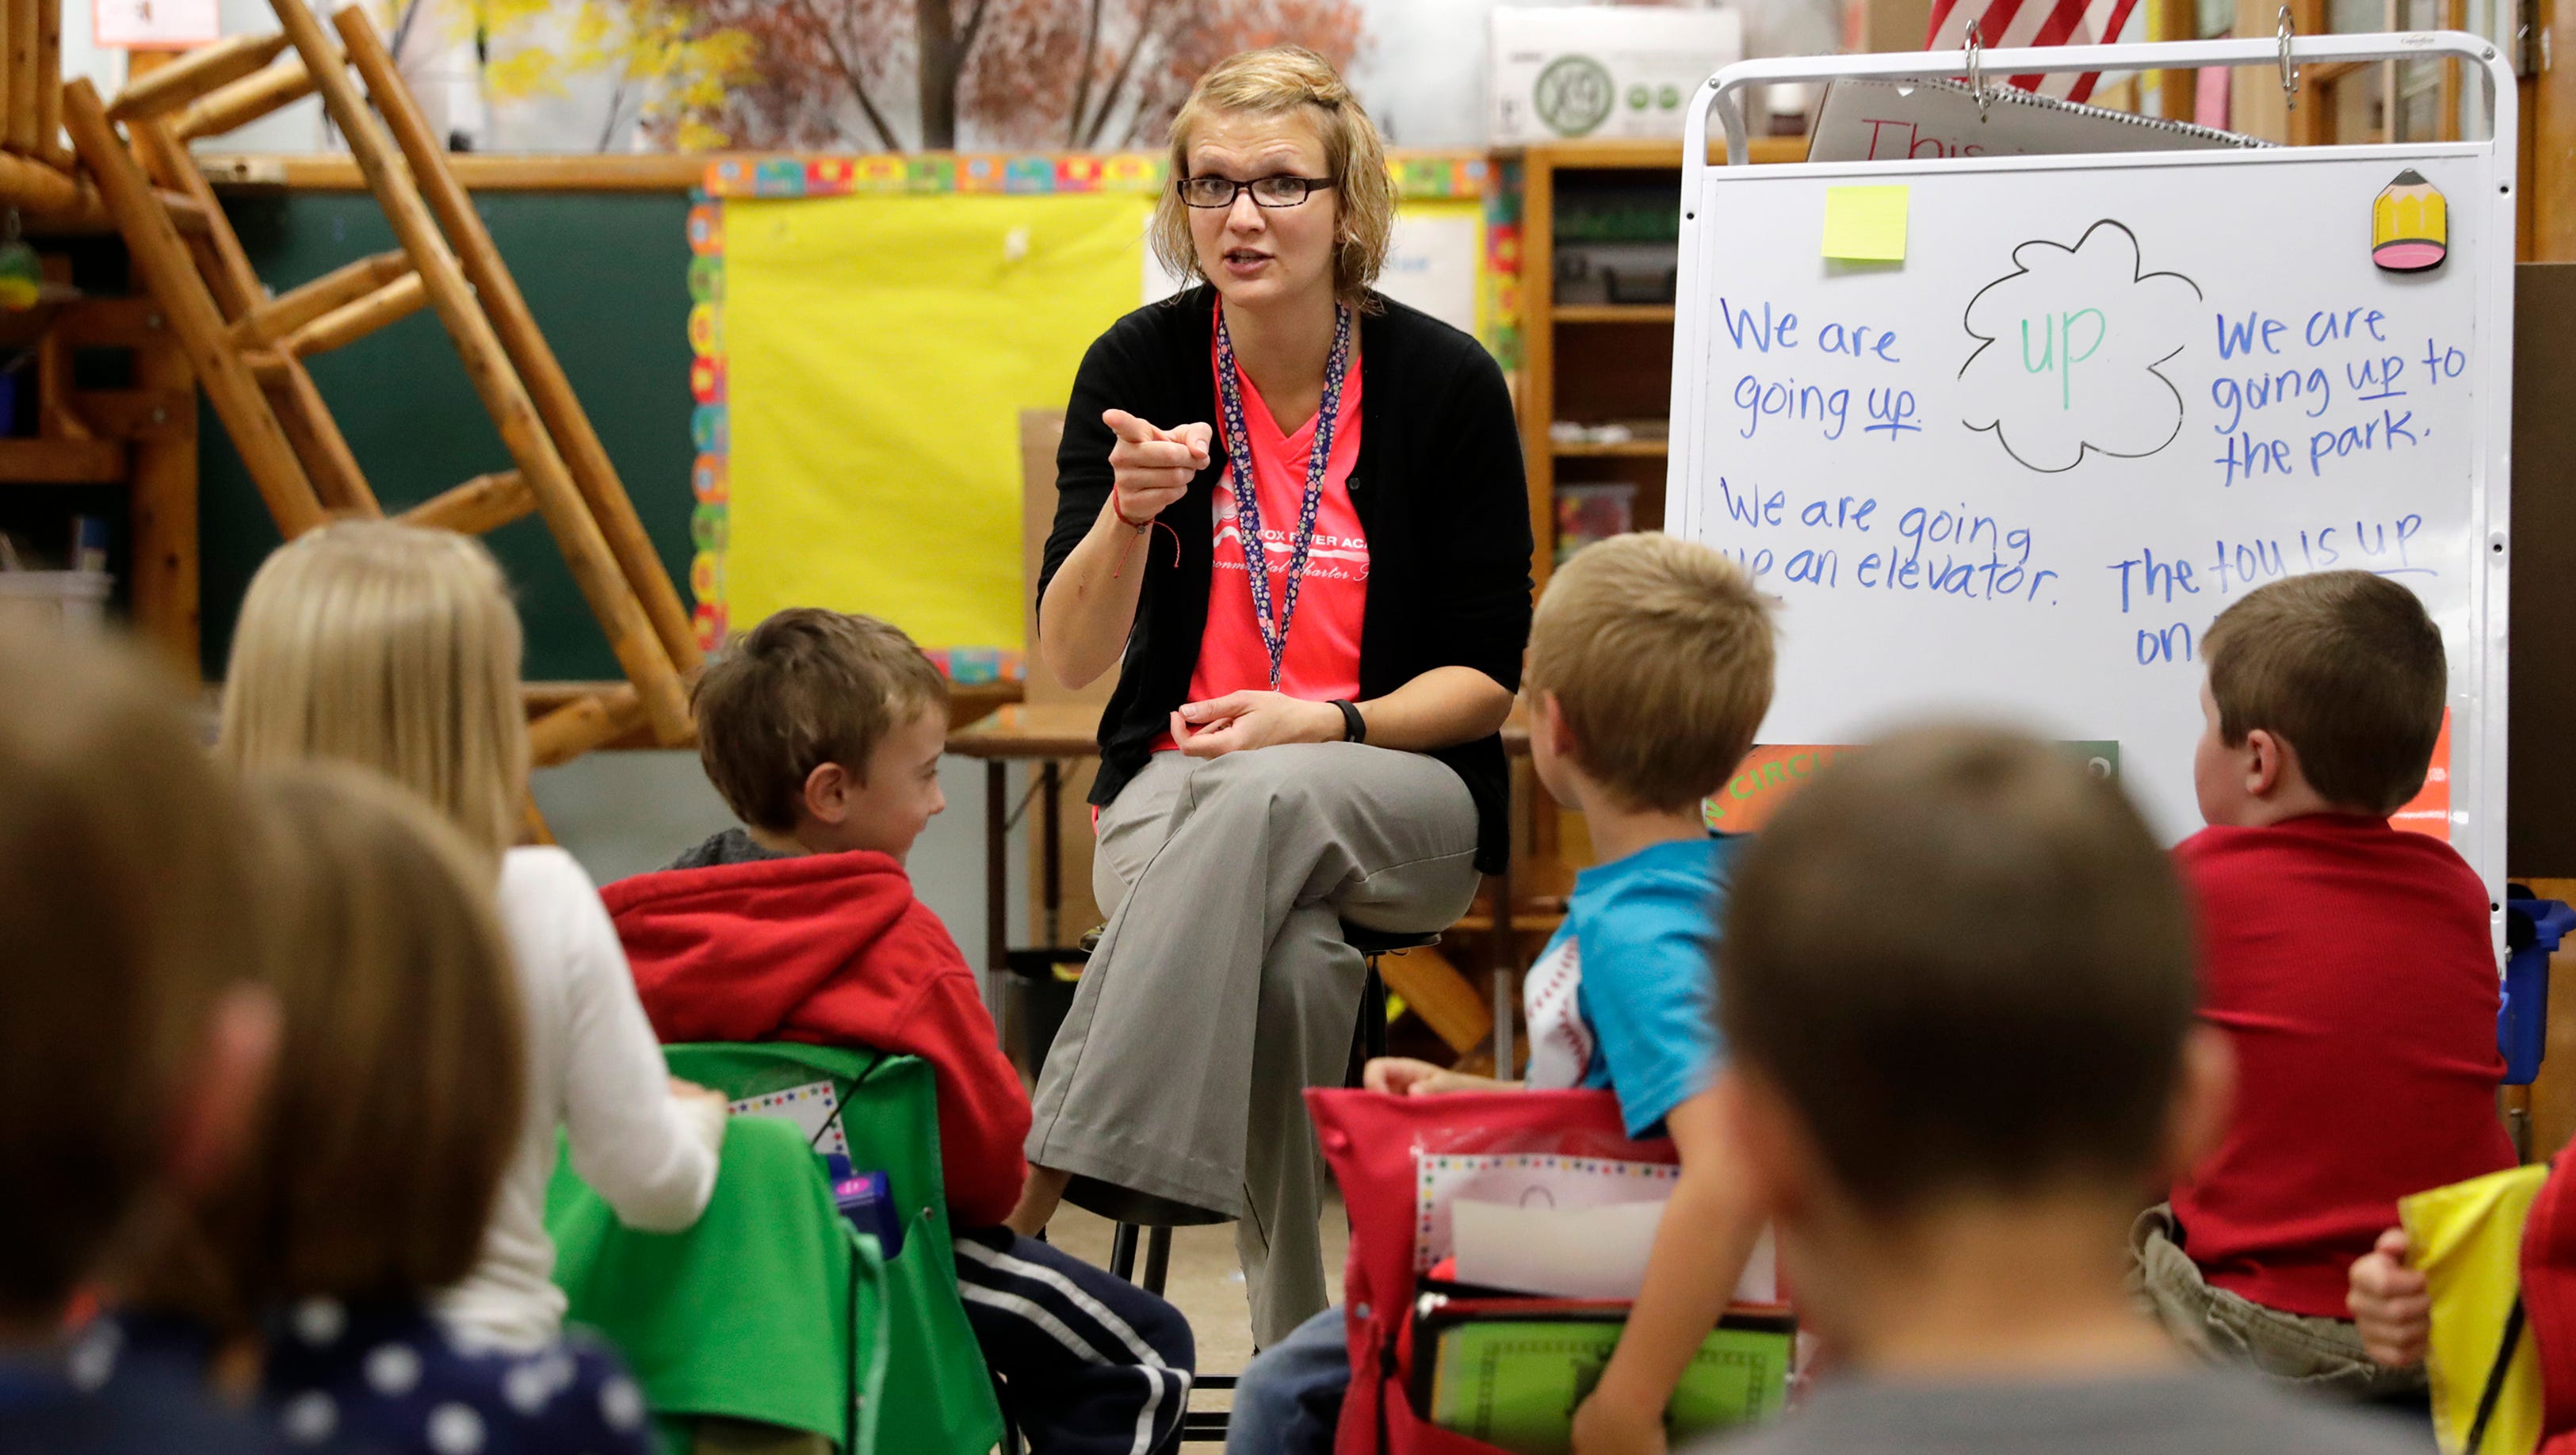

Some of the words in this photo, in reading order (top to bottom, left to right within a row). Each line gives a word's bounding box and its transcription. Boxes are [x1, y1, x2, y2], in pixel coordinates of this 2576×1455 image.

[1720, 297, 1798, 353] We
[1818, 323, 1901, 363] are
[2021, 307, 2106, 411] up
[2216, 311, 2288, 361] We
[2306, 307, 2386, 347] are
[2346, 356, 2406, 400] up
[2421, 338, 2466, 385] to
[1734, 375, 1849, 441] going
[1864, 388, 1922, 441] up.
[2214, 431, 2292, 487] the
[2310, 409, 2431, 476] park.
[1720, 476, 1785, 528] We
[1802, 496, 1877, 532] are
[1898, 503, 2031, 565] going
[1784, 549, 1837, 588] an
[1857, 546, 2058, 605] elevator.
[2106, 548, 2200, 613] The
[2356, 514, 2424, 569] up
[2136, 622, 2192, 665] on
[1729, 752, 1845, 800] CIRCL
